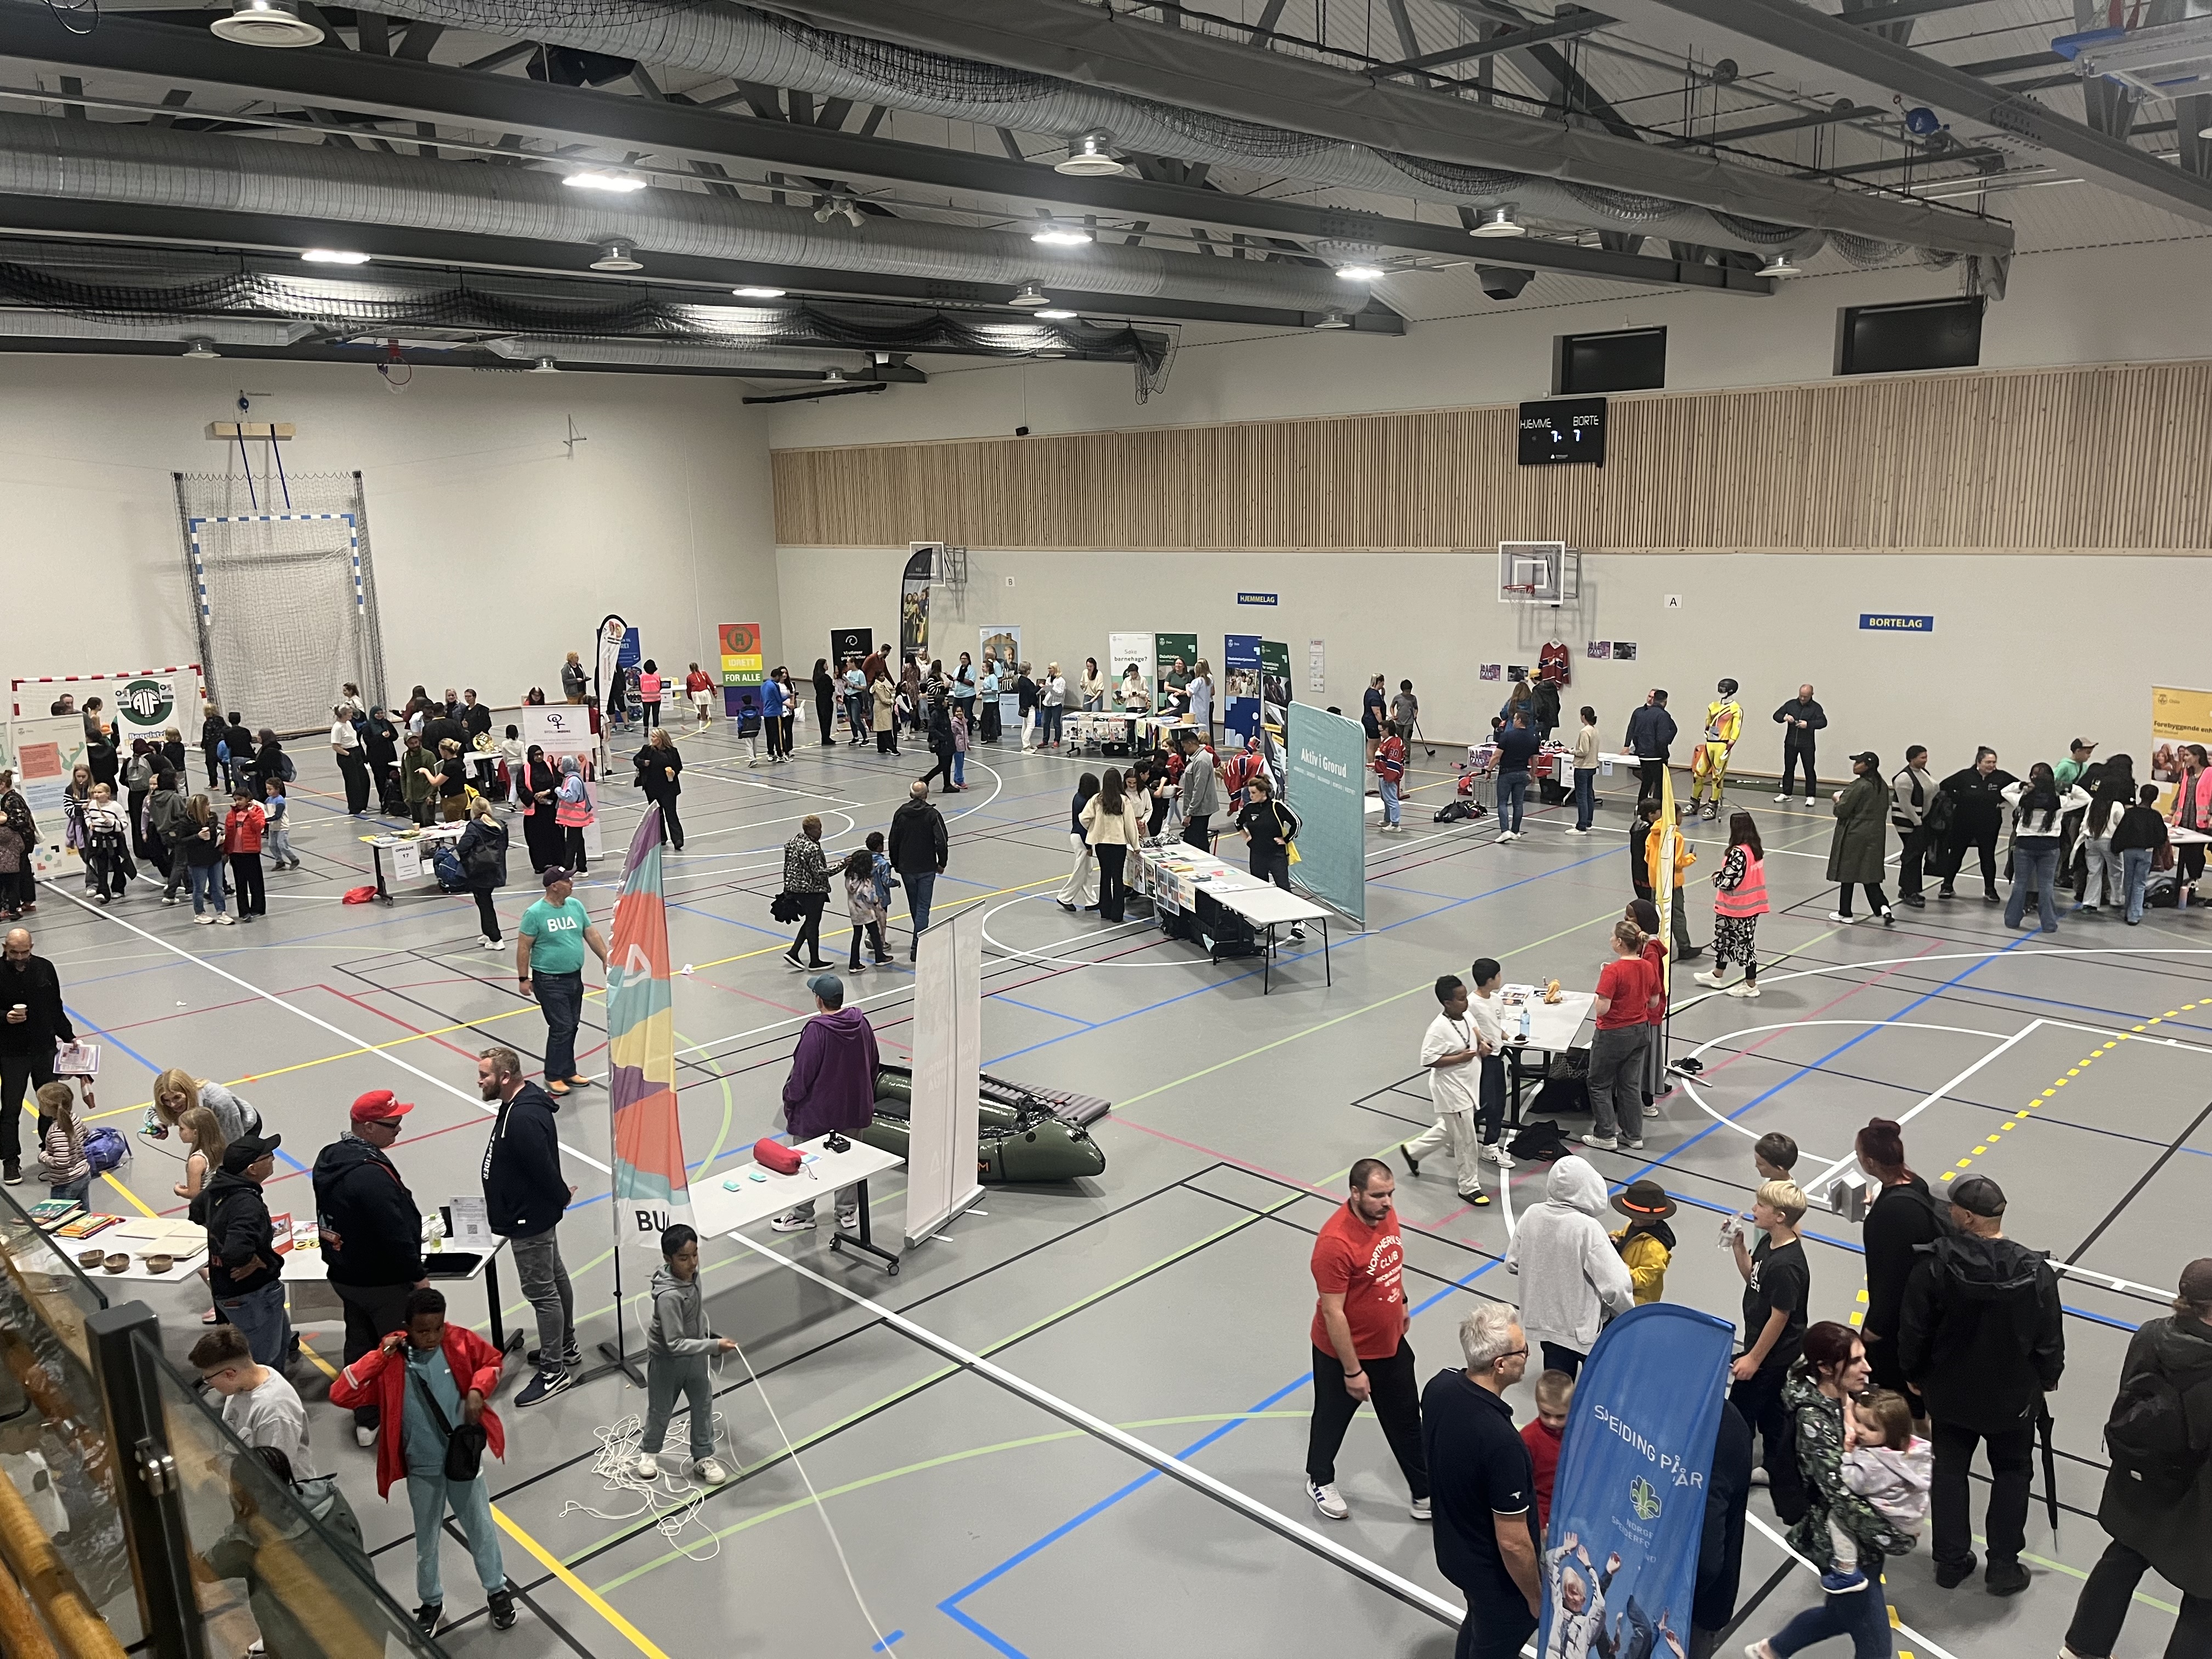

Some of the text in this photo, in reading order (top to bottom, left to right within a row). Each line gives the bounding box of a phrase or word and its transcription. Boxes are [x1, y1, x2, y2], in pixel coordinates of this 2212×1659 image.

[1520, 415, 1599, 429] HJEMME BORTE
[1669, 597, 1677, 607] A
[1869, 618, 1922, 628] BORTELAG
[728, 658, 755, 667] IDRETT
[725, 673, 761, 682] FOR ALLE
[133, 691, 160, 715] AIF
[1301, 748, 1347, 778] Aktiv i Grorud
[547, 916, 578, 932] BUA
[1365, 1234, 1396, 1276] NORTHERN
[1380, 1250, 1398, 1269] CLUB
[1673, 1468, 1703, 1489] ÅR
